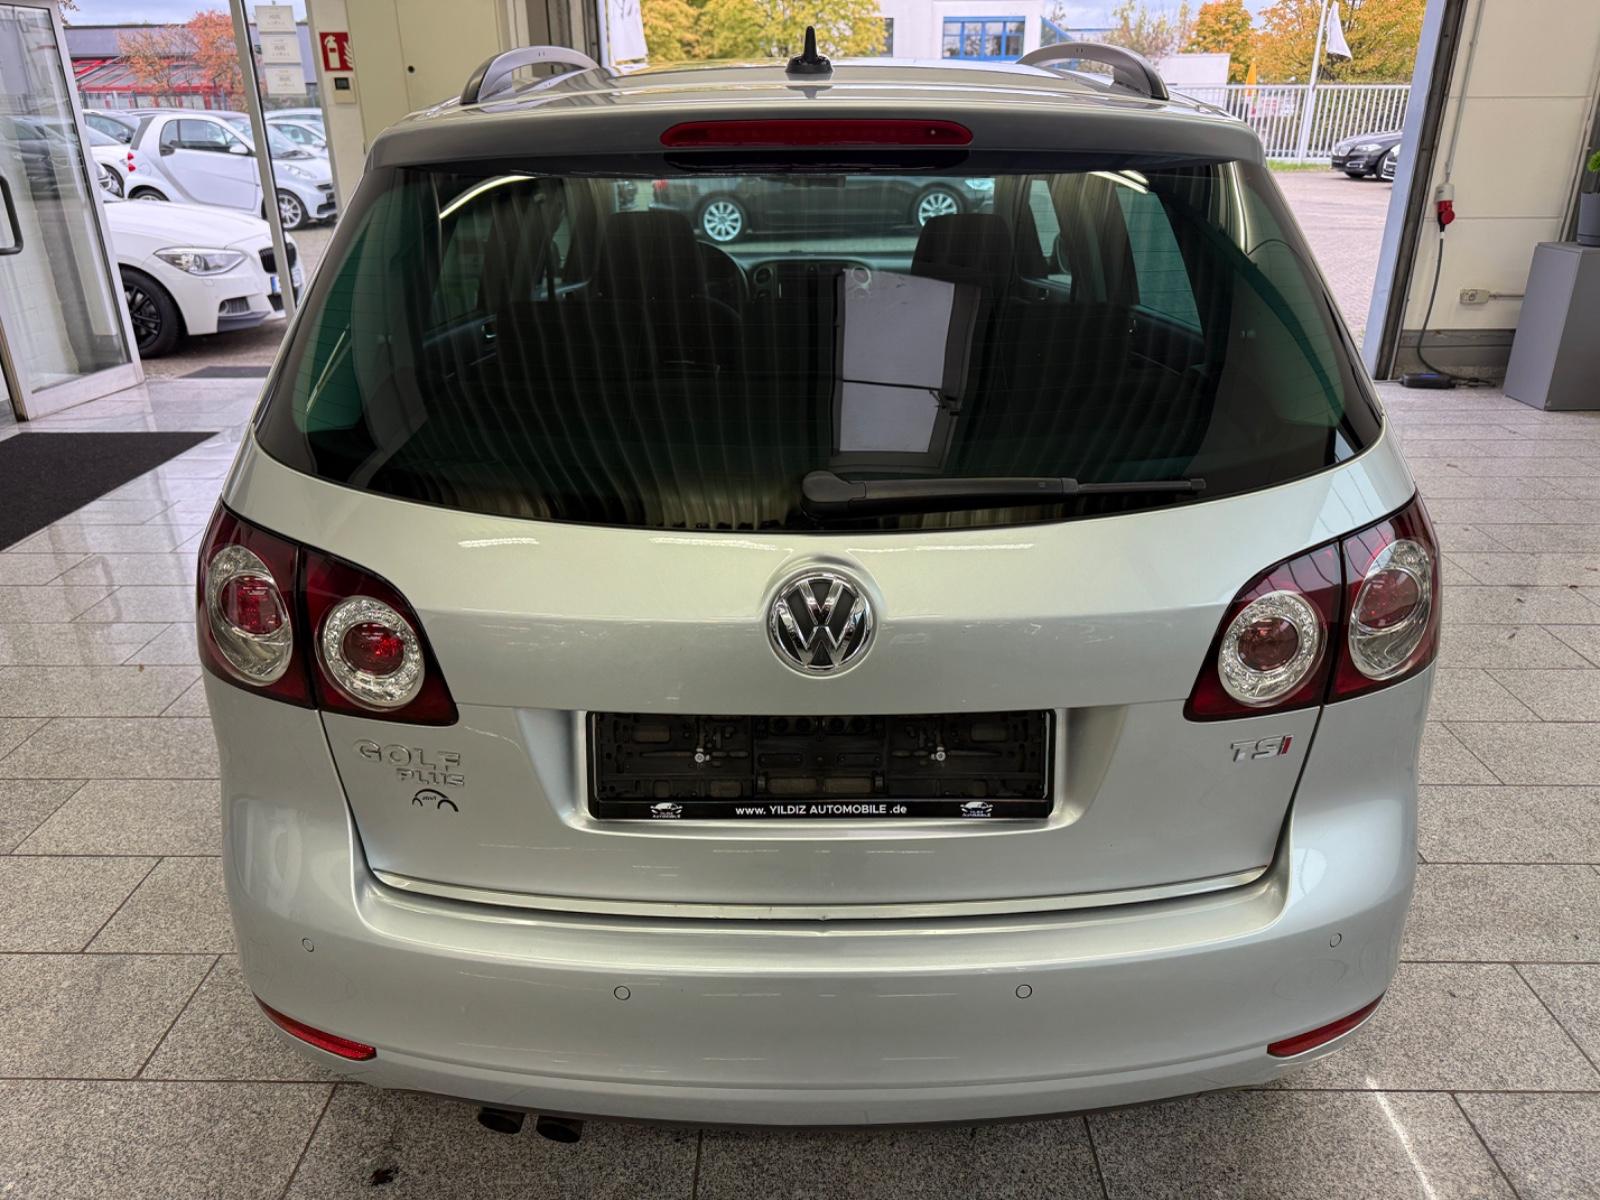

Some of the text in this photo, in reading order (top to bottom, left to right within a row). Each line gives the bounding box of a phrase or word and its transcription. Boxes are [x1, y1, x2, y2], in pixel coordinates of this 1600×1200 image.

[353, 739, 461, 772] GOLF
[735, 804, 908, 815] www. YILDIZ AUTOMOBILE .de
